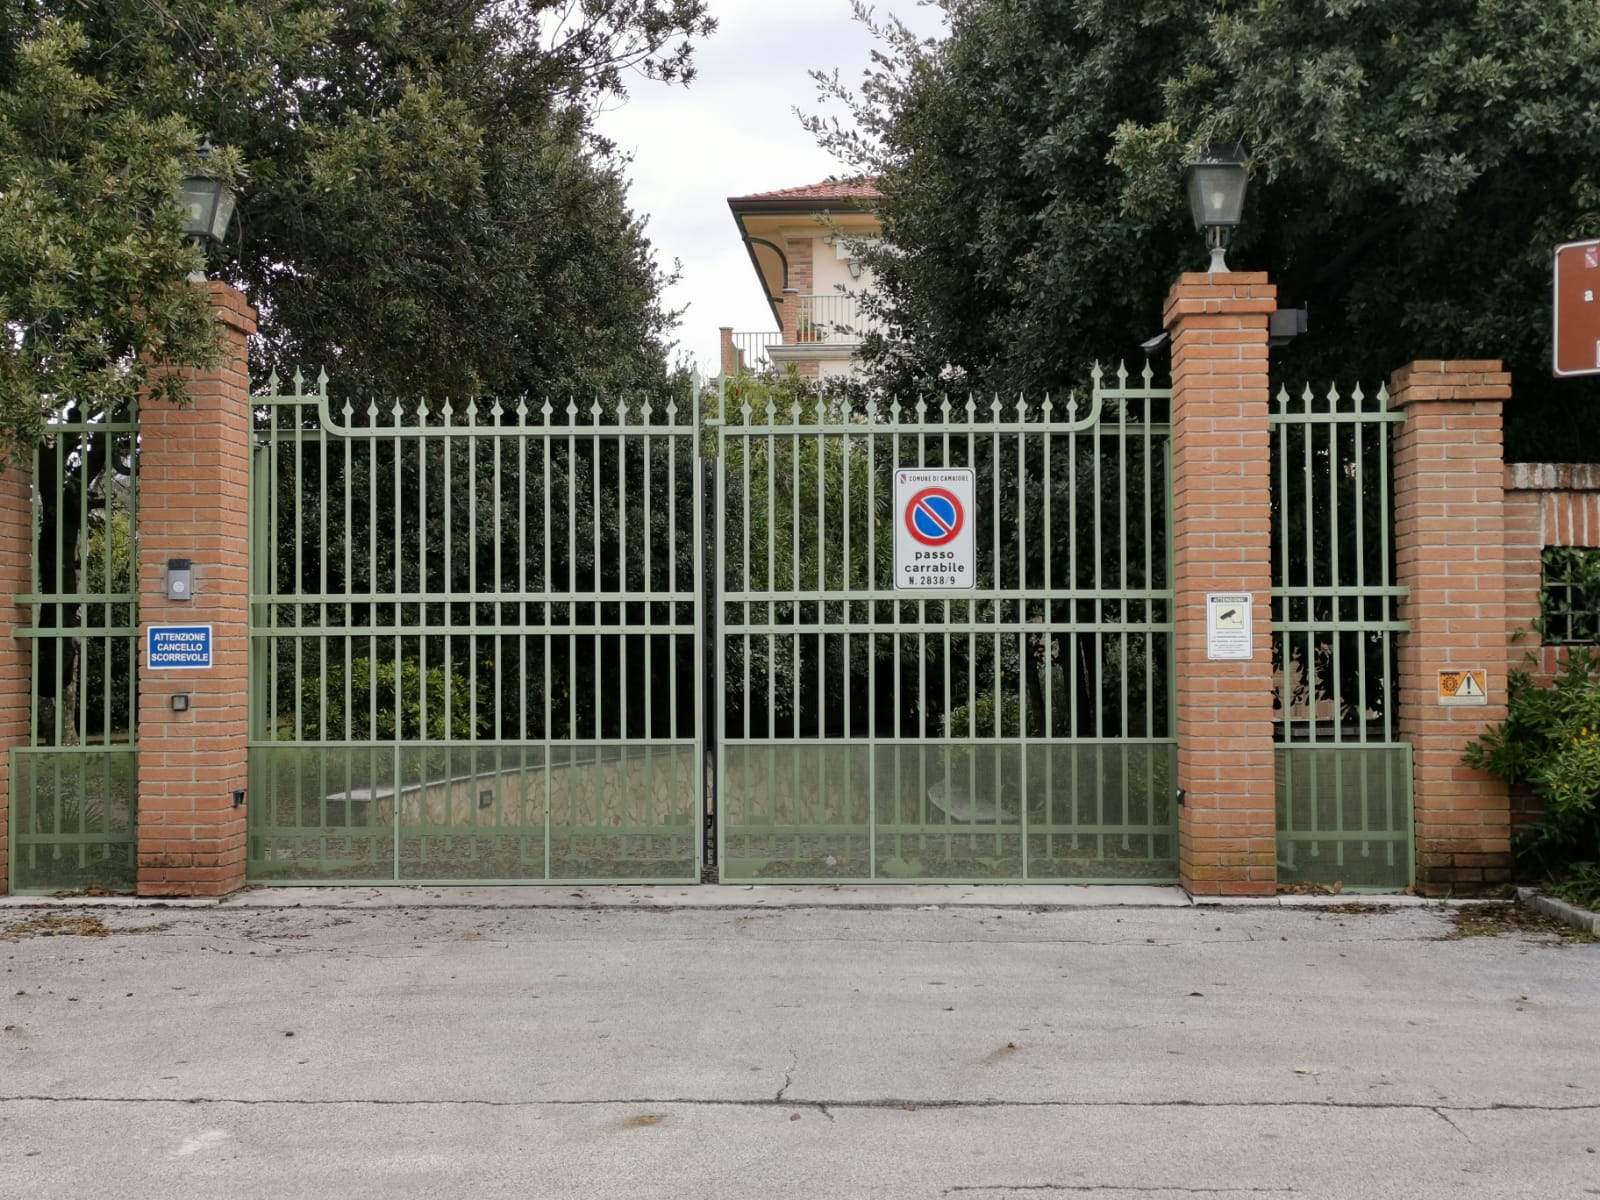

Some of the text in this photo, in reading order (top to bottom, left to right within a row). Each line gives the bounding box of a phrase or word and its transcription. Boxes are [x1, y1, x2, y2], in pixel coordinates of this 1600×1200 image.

[915, 551, 954, 560] passo
[904, 562, 965, 572] carrabile
[920, 576, 956, 585] 2838/9
[153, 632, 206, 641] ATTENZIONE
[157, 643, 203, 651] CANCELLO
[151, 653, 208, 662] SCORREVOLE
